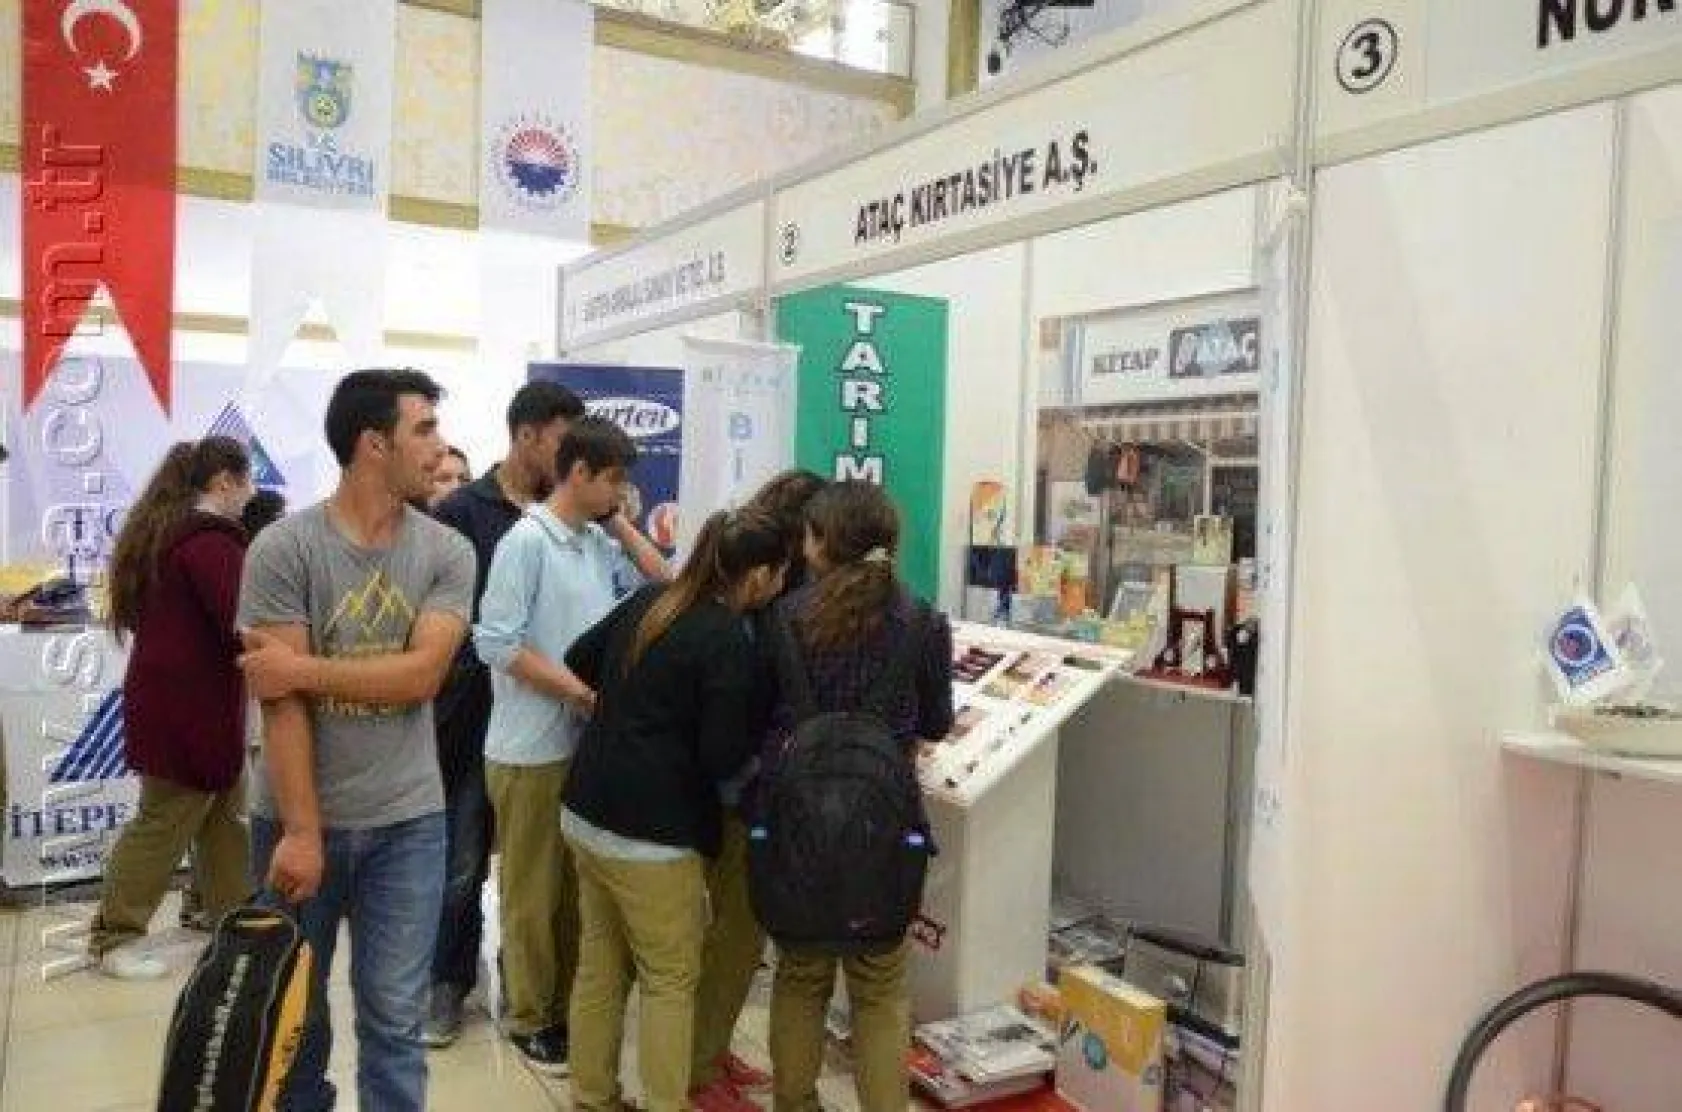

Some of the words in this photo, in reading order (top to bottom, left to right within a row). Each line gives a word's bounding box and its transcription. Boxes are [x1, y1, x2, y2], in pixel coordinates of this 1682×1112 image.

[1351, 32, 1382, 79] 3
[854, 192, 904, 246] ATAÇ
[911, 148, 1036, 228] KIRTASİYE
[1043, 129, 1098, 192] A.Ş.
[835, 301, 885, 485] TARIM
